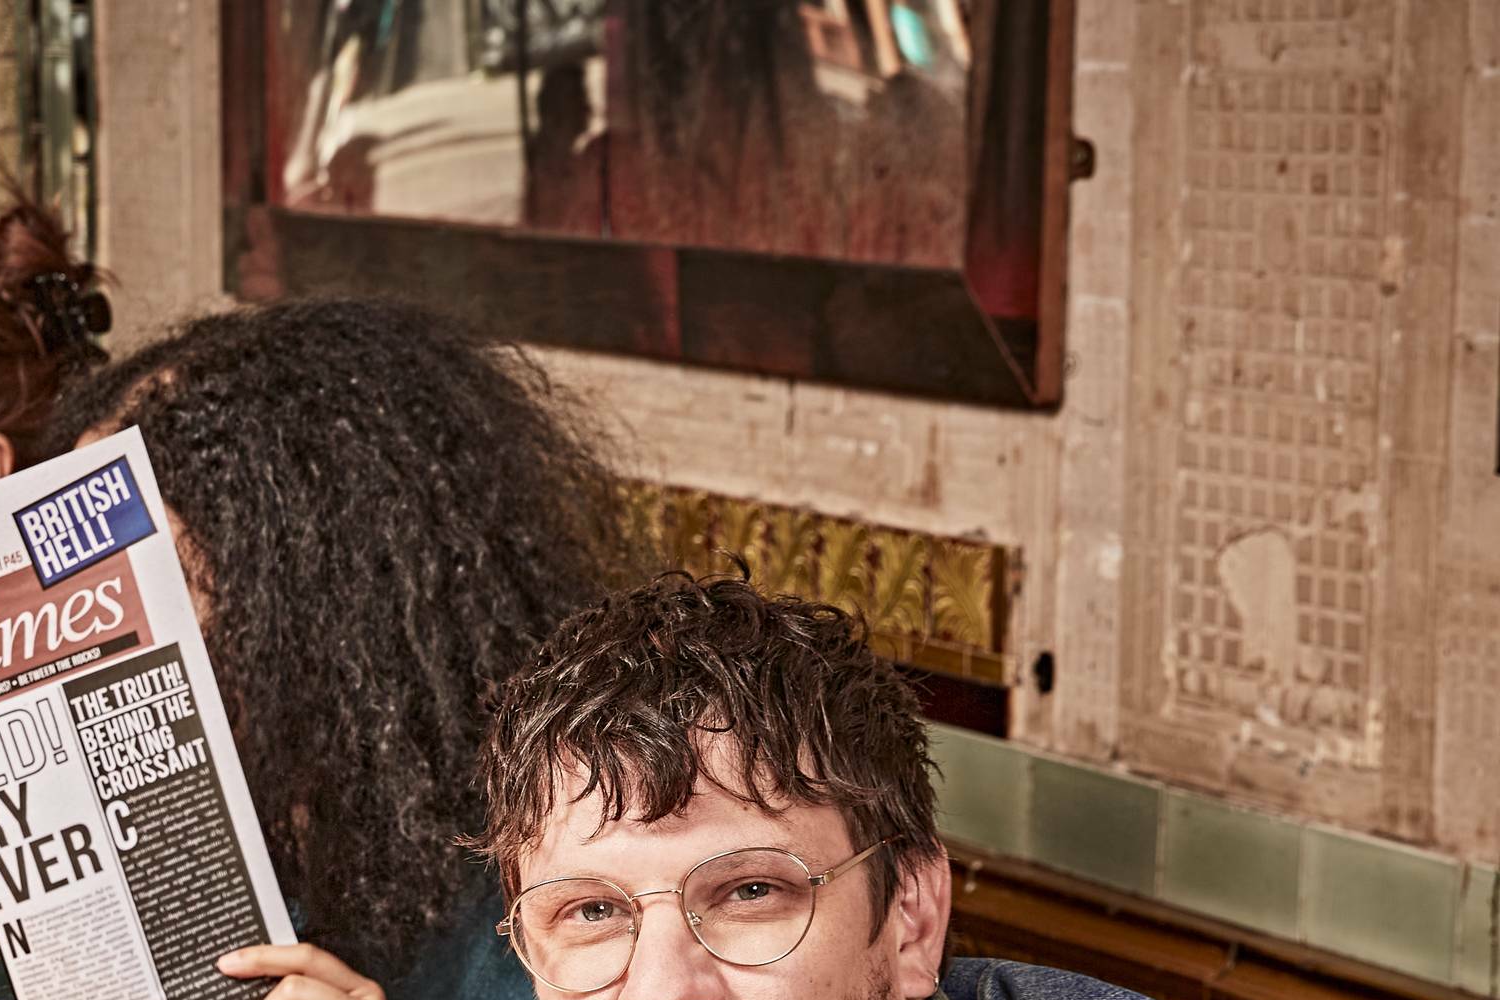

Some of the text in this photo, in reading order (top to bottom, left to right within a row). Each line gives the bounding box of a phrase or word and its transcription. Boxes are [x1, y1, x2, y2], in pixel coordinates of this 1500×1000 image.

[21, 467, 131, 547] BRITISH
[3, 551, 24, 568] P45
[34, 515, 116, 578] HELL!
[17, 664, 58, 687] BETWEEN
[57, 658, 73, 672] THE
[69, 661, 186, 723] THE TRUTH!
[78, 691, 196, 752] BEHIND THE
[86, 724, 176, 778] FUCKING
[95, 737, 208, 801] CROISSANT
[104, 800, 139, 852] C
[4, 918, 31, 960] N
